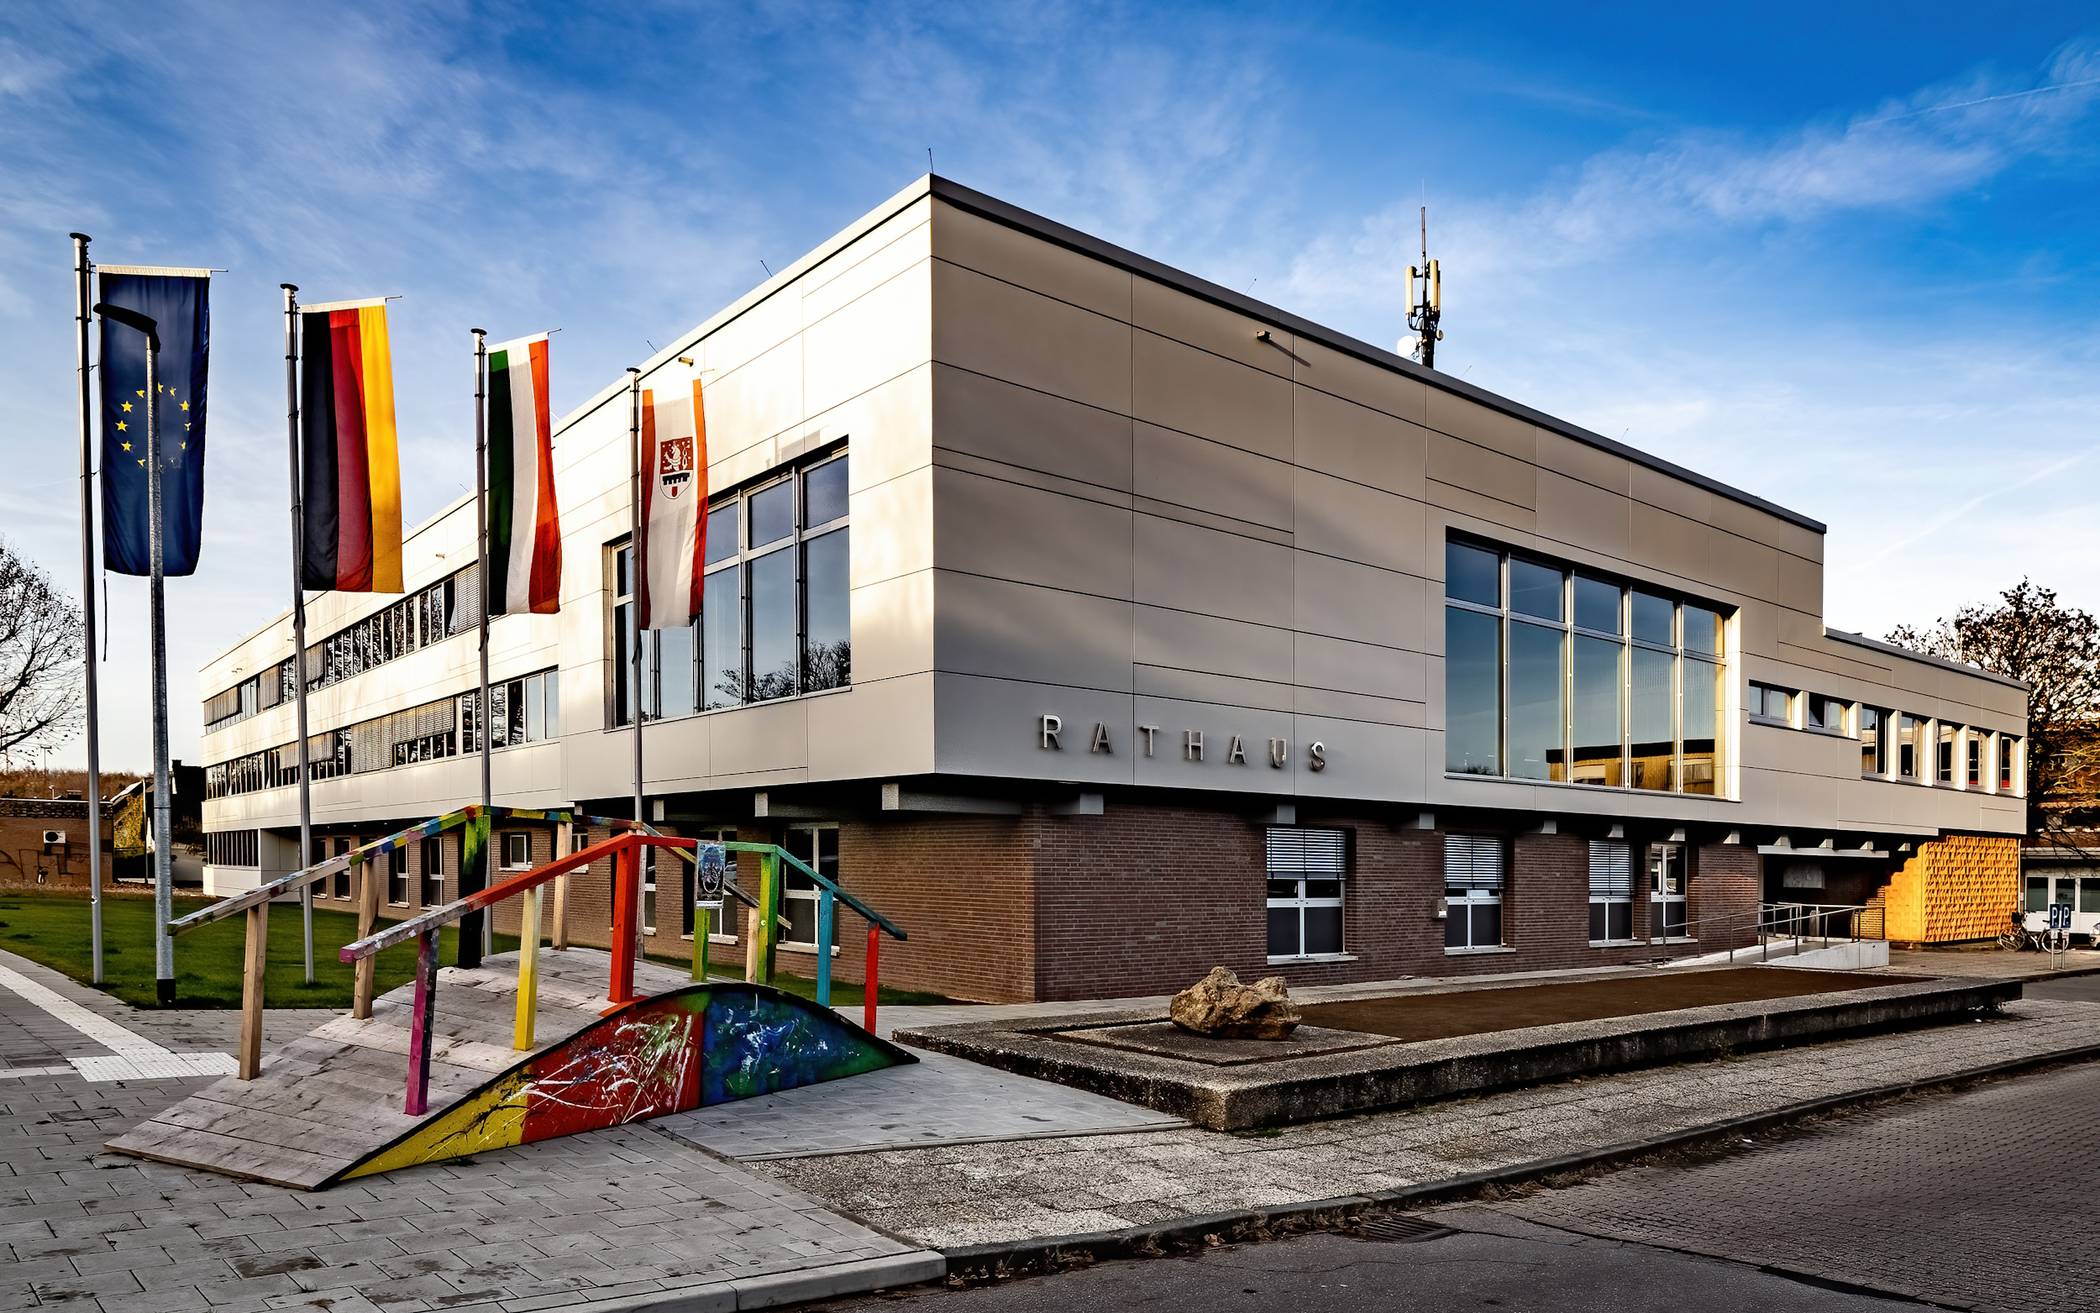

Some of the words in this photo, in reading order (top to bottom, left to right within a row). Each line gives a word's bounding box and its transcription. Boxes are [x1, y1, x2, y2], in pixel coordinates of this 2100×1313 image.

[1041, 714, 1326, 771] RATHAUS
[2051, 906, 2058, 927] P
[2062, 906, 2070, 926] P
